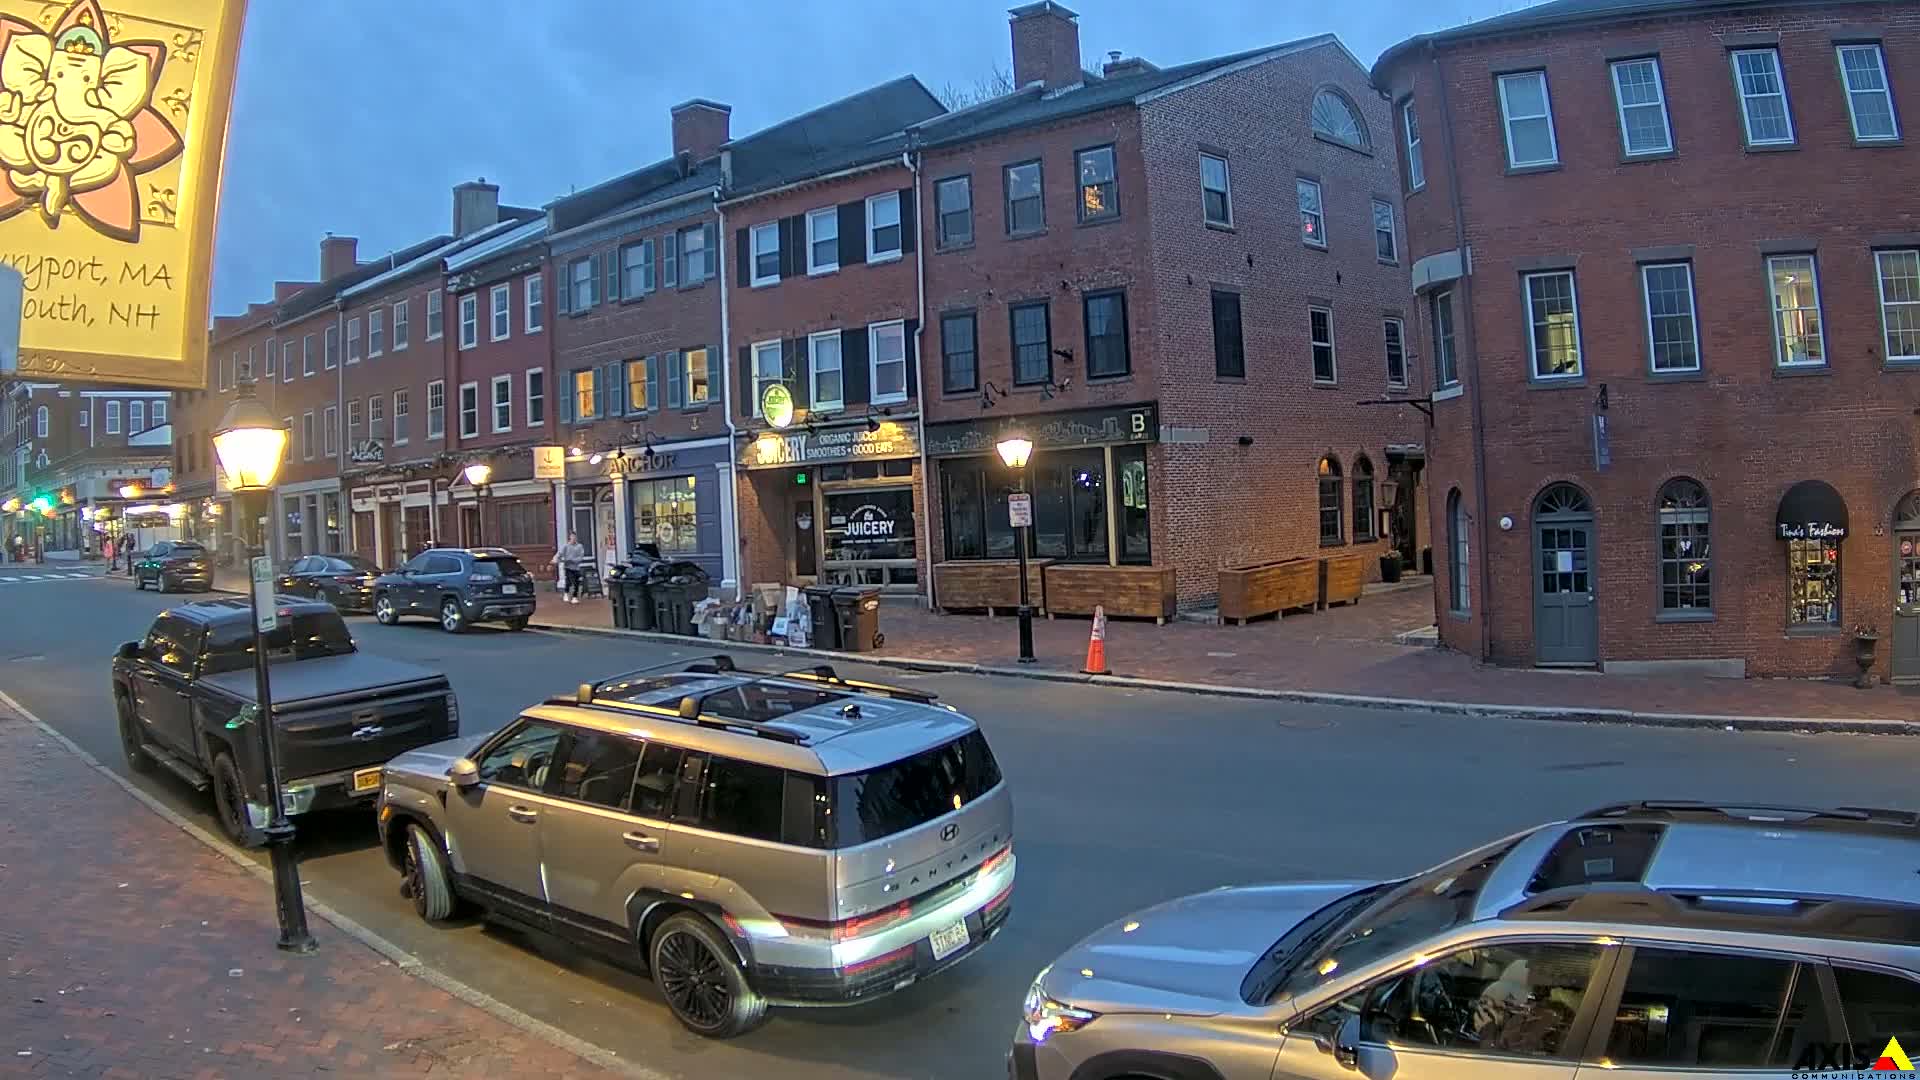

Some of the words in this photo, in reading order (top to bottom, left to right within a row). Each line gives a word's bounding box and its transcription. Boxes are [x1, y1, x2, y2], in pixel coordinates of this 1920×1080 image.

[1, 253, 108, 292] ryport,
[119, 261, 172, 290] MA
[109, 301, 160, 331] NH
[1131, 413, 1145, 433] B
[853, 443, 875, 456] GOOD
[876, 441, 893, 454] EATS
[609, 453, 676, 473] ANCHOR
[844, 520, 895, 536] JUICERY
